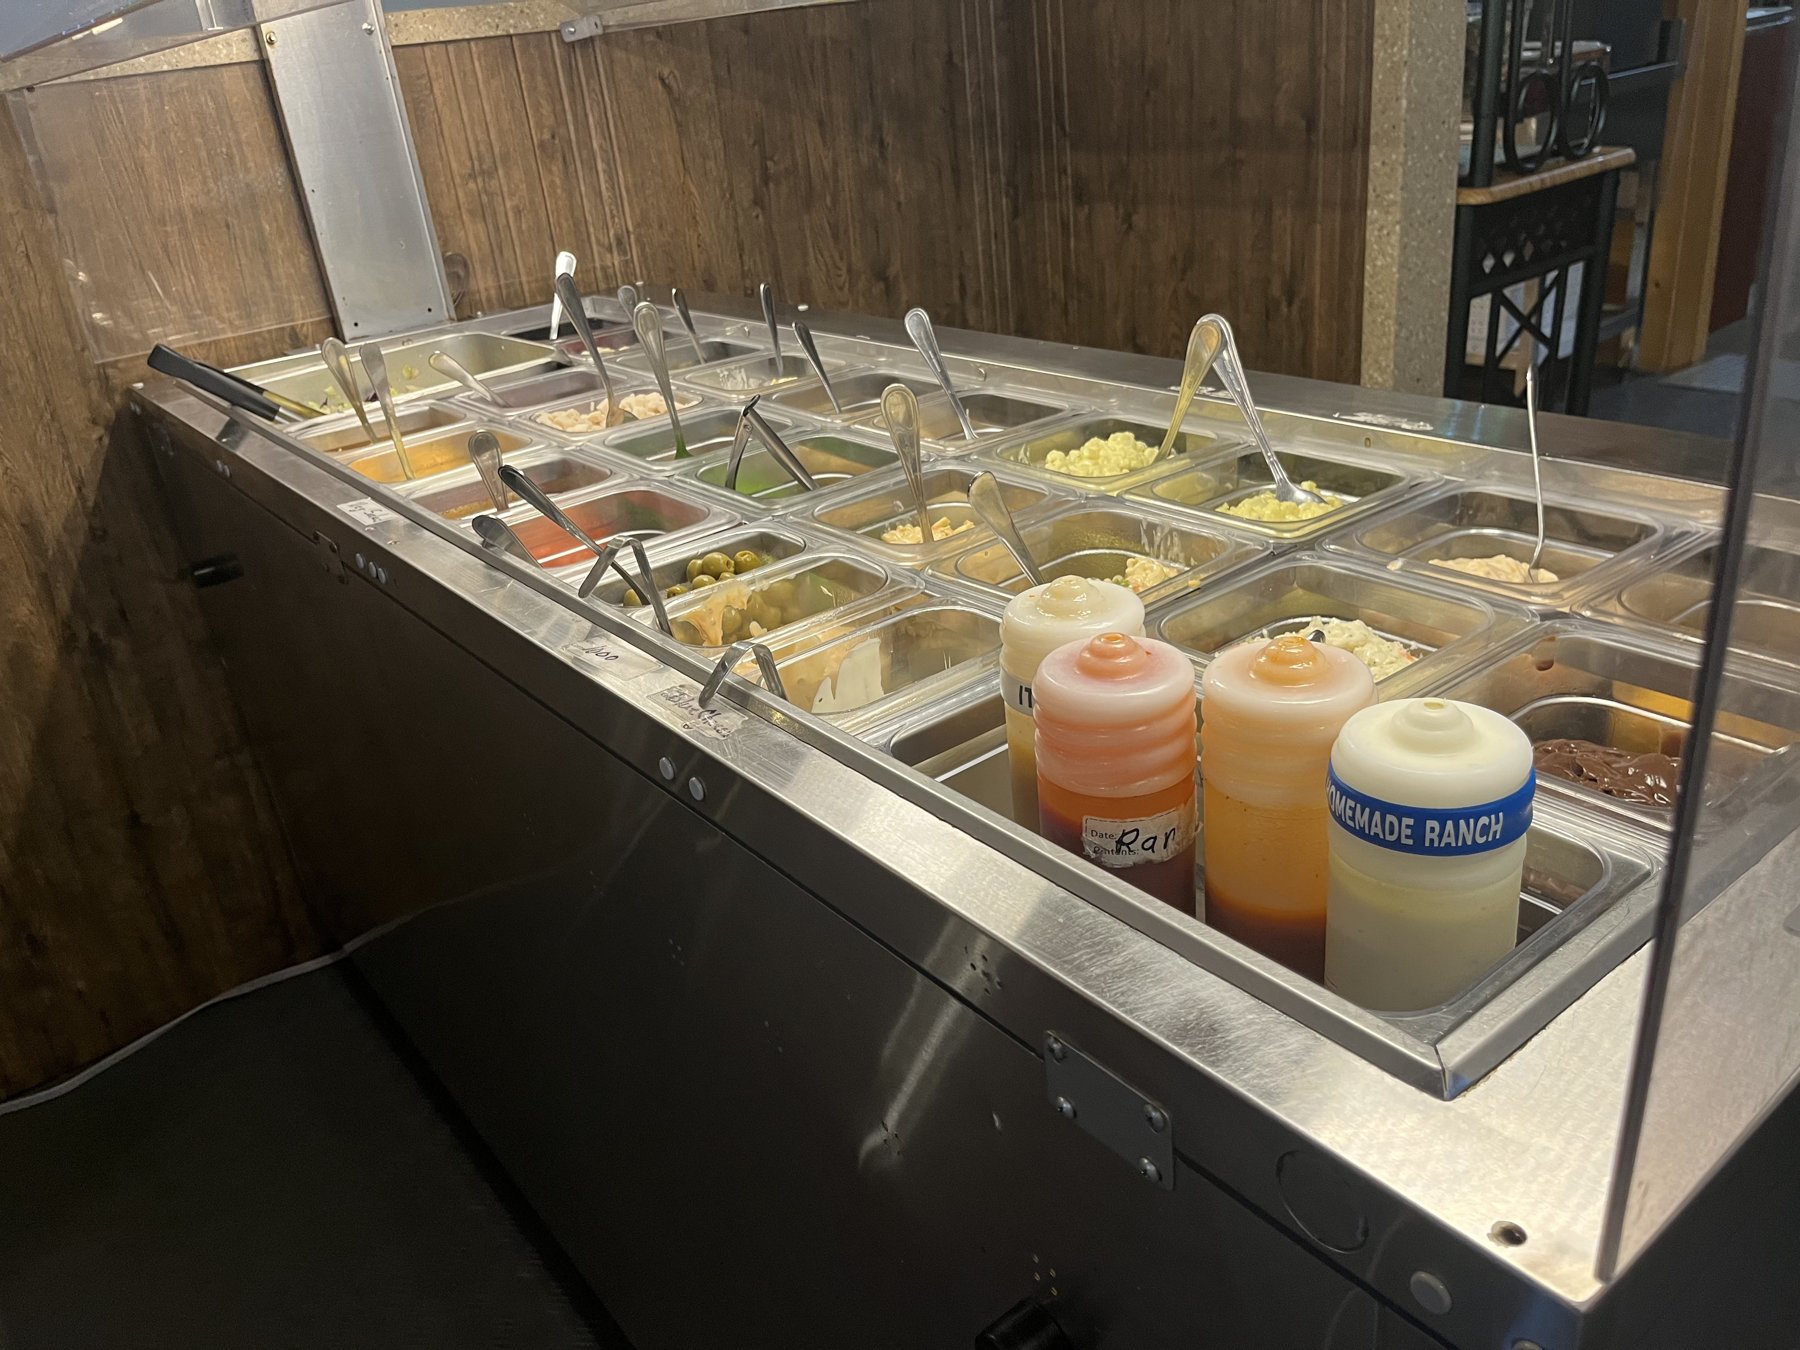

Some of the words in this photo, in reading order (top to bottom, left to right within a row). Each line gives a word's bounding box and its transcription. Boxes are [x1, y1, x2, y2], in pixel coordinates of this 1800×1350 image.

[1090, 829, 1117, 840] Date:
[1424, 811, 1505, 848] RANCH
[1093, 845, 1140, 856] Cntnts:
